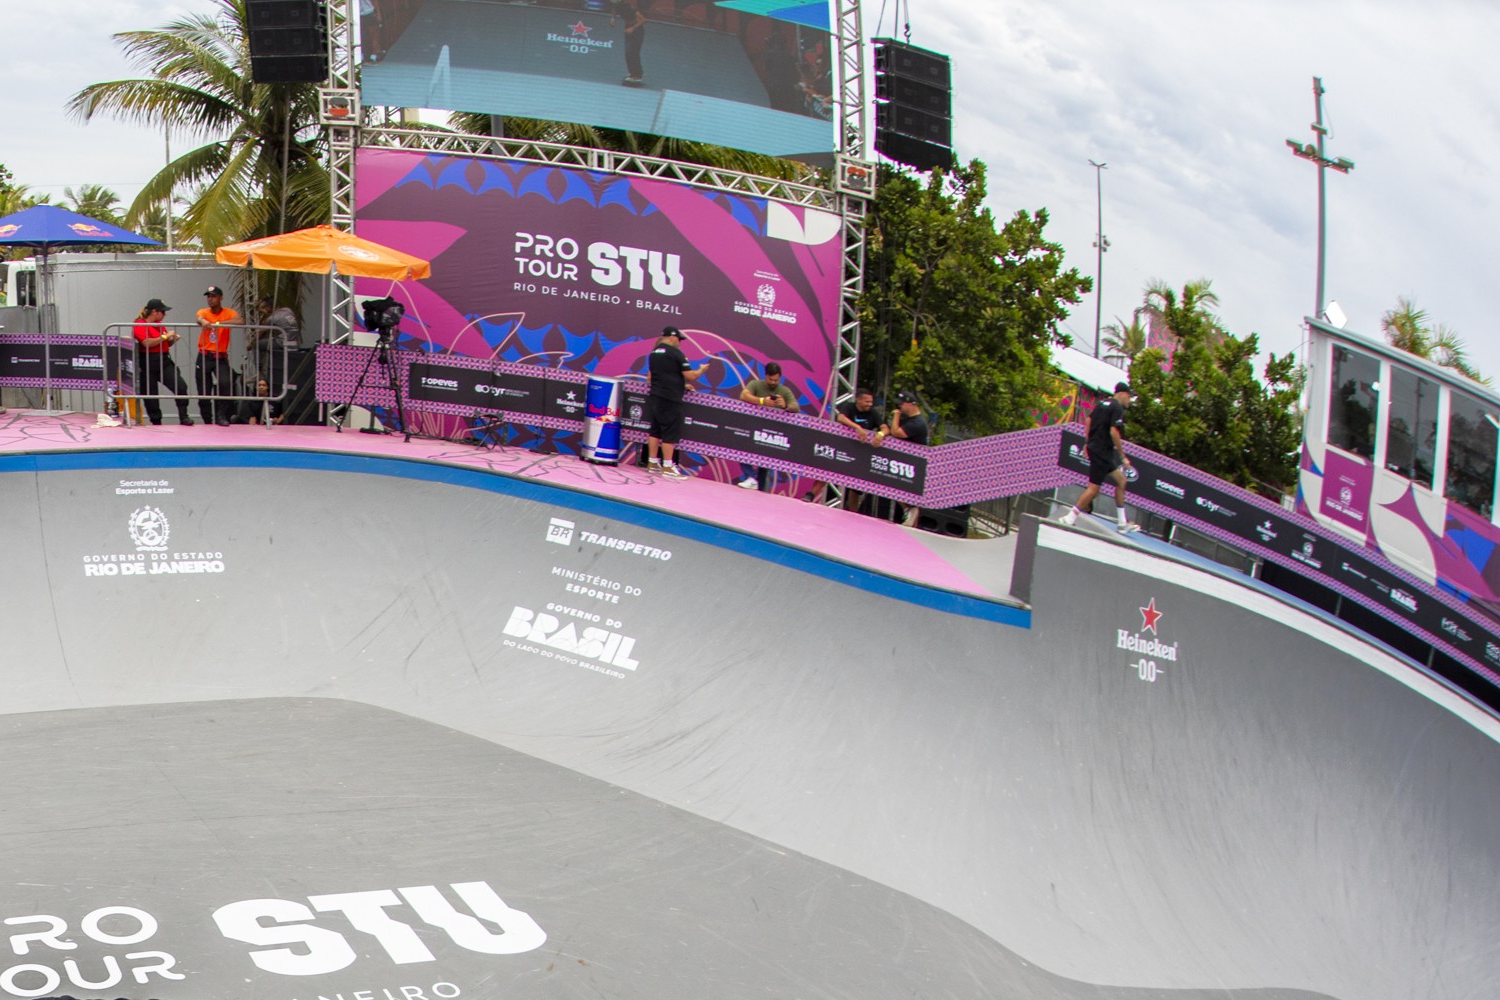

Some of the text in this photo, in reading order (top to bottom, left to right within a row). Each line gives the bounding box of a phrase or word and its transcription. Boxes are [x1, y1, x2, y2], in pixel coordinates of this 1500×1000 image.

[547, 33, 612, 48] Heineken
[515, 232, 579, 260] PRO
[514, 257, 578, 281] TOUR
[587, 242, 684, 296] STU
[514, 282, 682, 315] RIO DE JANEIRO BRAZIL
[750, 308, 761, 317] DE
[762, 311, 797, 324] JANEIRO
[72, 357, 104, 368] BRASIL
[753, 430, 790, 448] BRASIL
[870, 454, 889, 465] PRO
[889, 460, 915, 479] STU
[115, 487, 146, 496] Esporte
[153, 487, 174, 495] Lazer
[120, 479, 169, 487] Secretaria de
[83, 551, 223, 562] GOVERNO DO ESTADO
[580, 531, 672, 561] TRANSPETRO
[84, 560, 225, 577] RIO DE JANEIRO
[552, 566, 642, 597] MINISTÉRIO DO
[565, 583, 620, 604] ESPORTE
[546, 602, 622, 629] GOVERNO DO
[502, 605, 639, 671] BRASIL
[1117, 629, 1177, 661] Heineken
[503, 639, 626, 679] DO LADO DO POVO BRASILEIRO
[211, 881, 548, 977] STU
